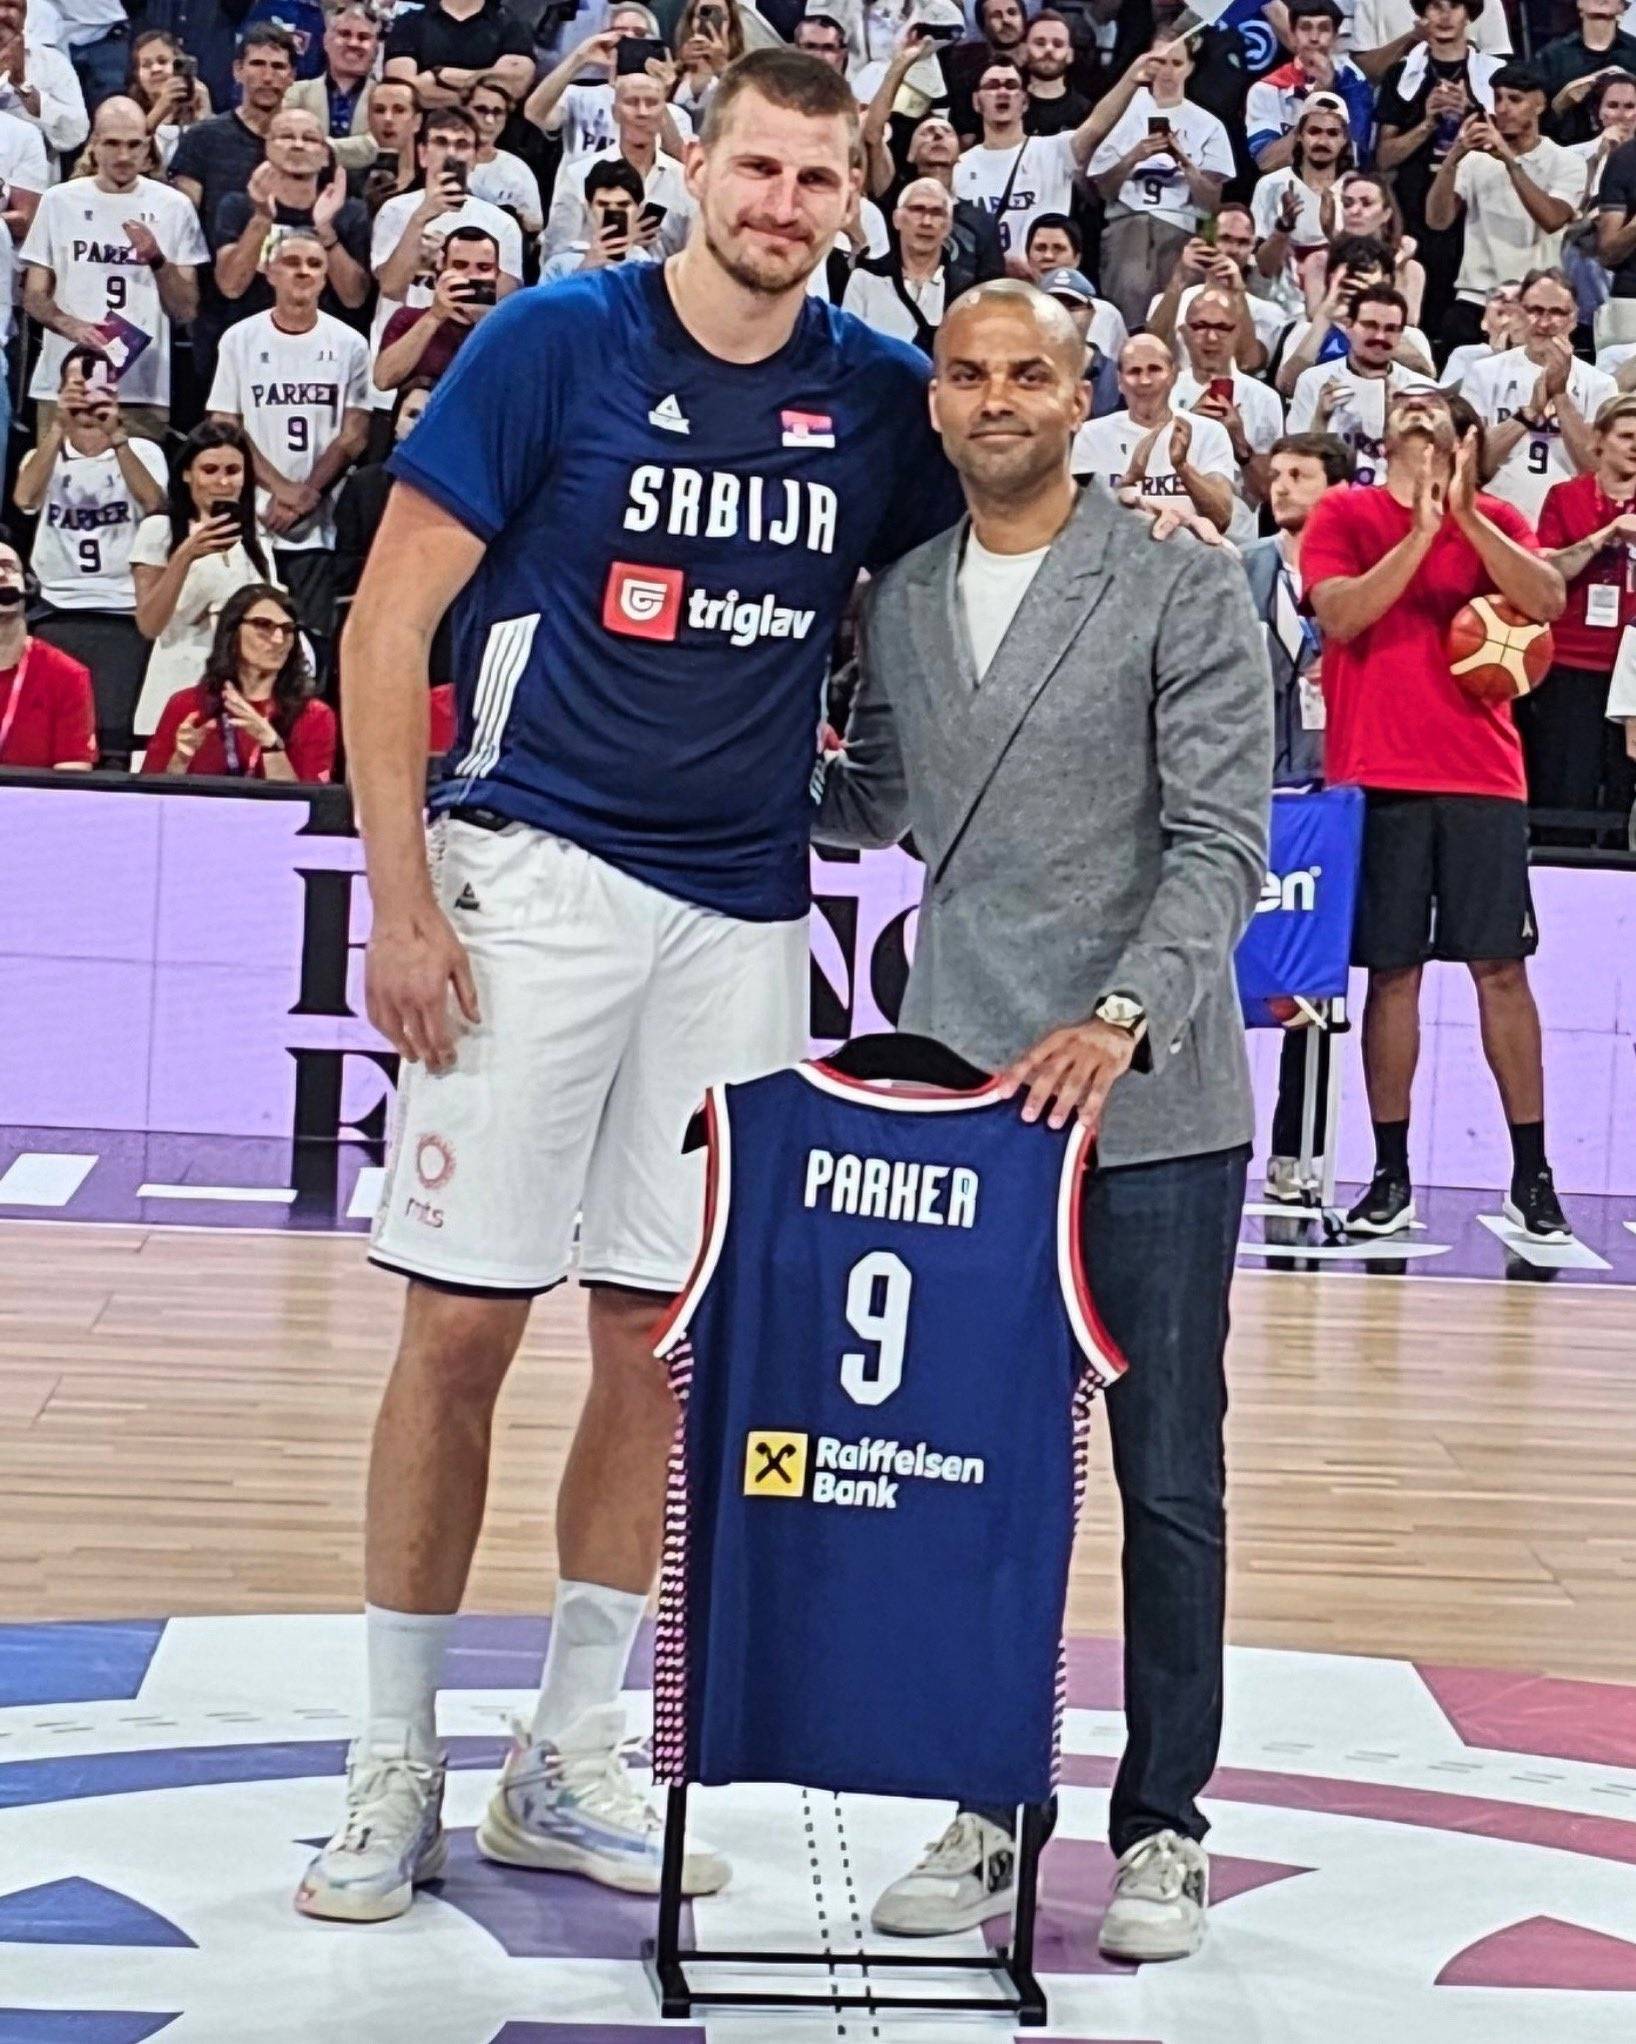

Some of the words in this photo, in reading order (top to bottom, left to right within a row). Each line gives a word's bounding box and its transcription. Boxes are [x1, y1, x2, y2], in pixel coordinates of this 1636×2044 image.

[1143, 178, 1163, 206] 9
[106, 275, 127, 309] 9
[287, 416, 309, 452] 9
[1528, 441, 1550, 475] 9
[623, 464, 839, 554] SRBIJA
[79, 539, 102, 574] 9
[688, 588, 816, 647] triglav
[803, 1148, 979, 1229] PARKER
[840, 1251, 912, 1406] 9
[815, 1435, 985, 1484] Raiffeisen
[812, 1473, 899, 1509] Bank
